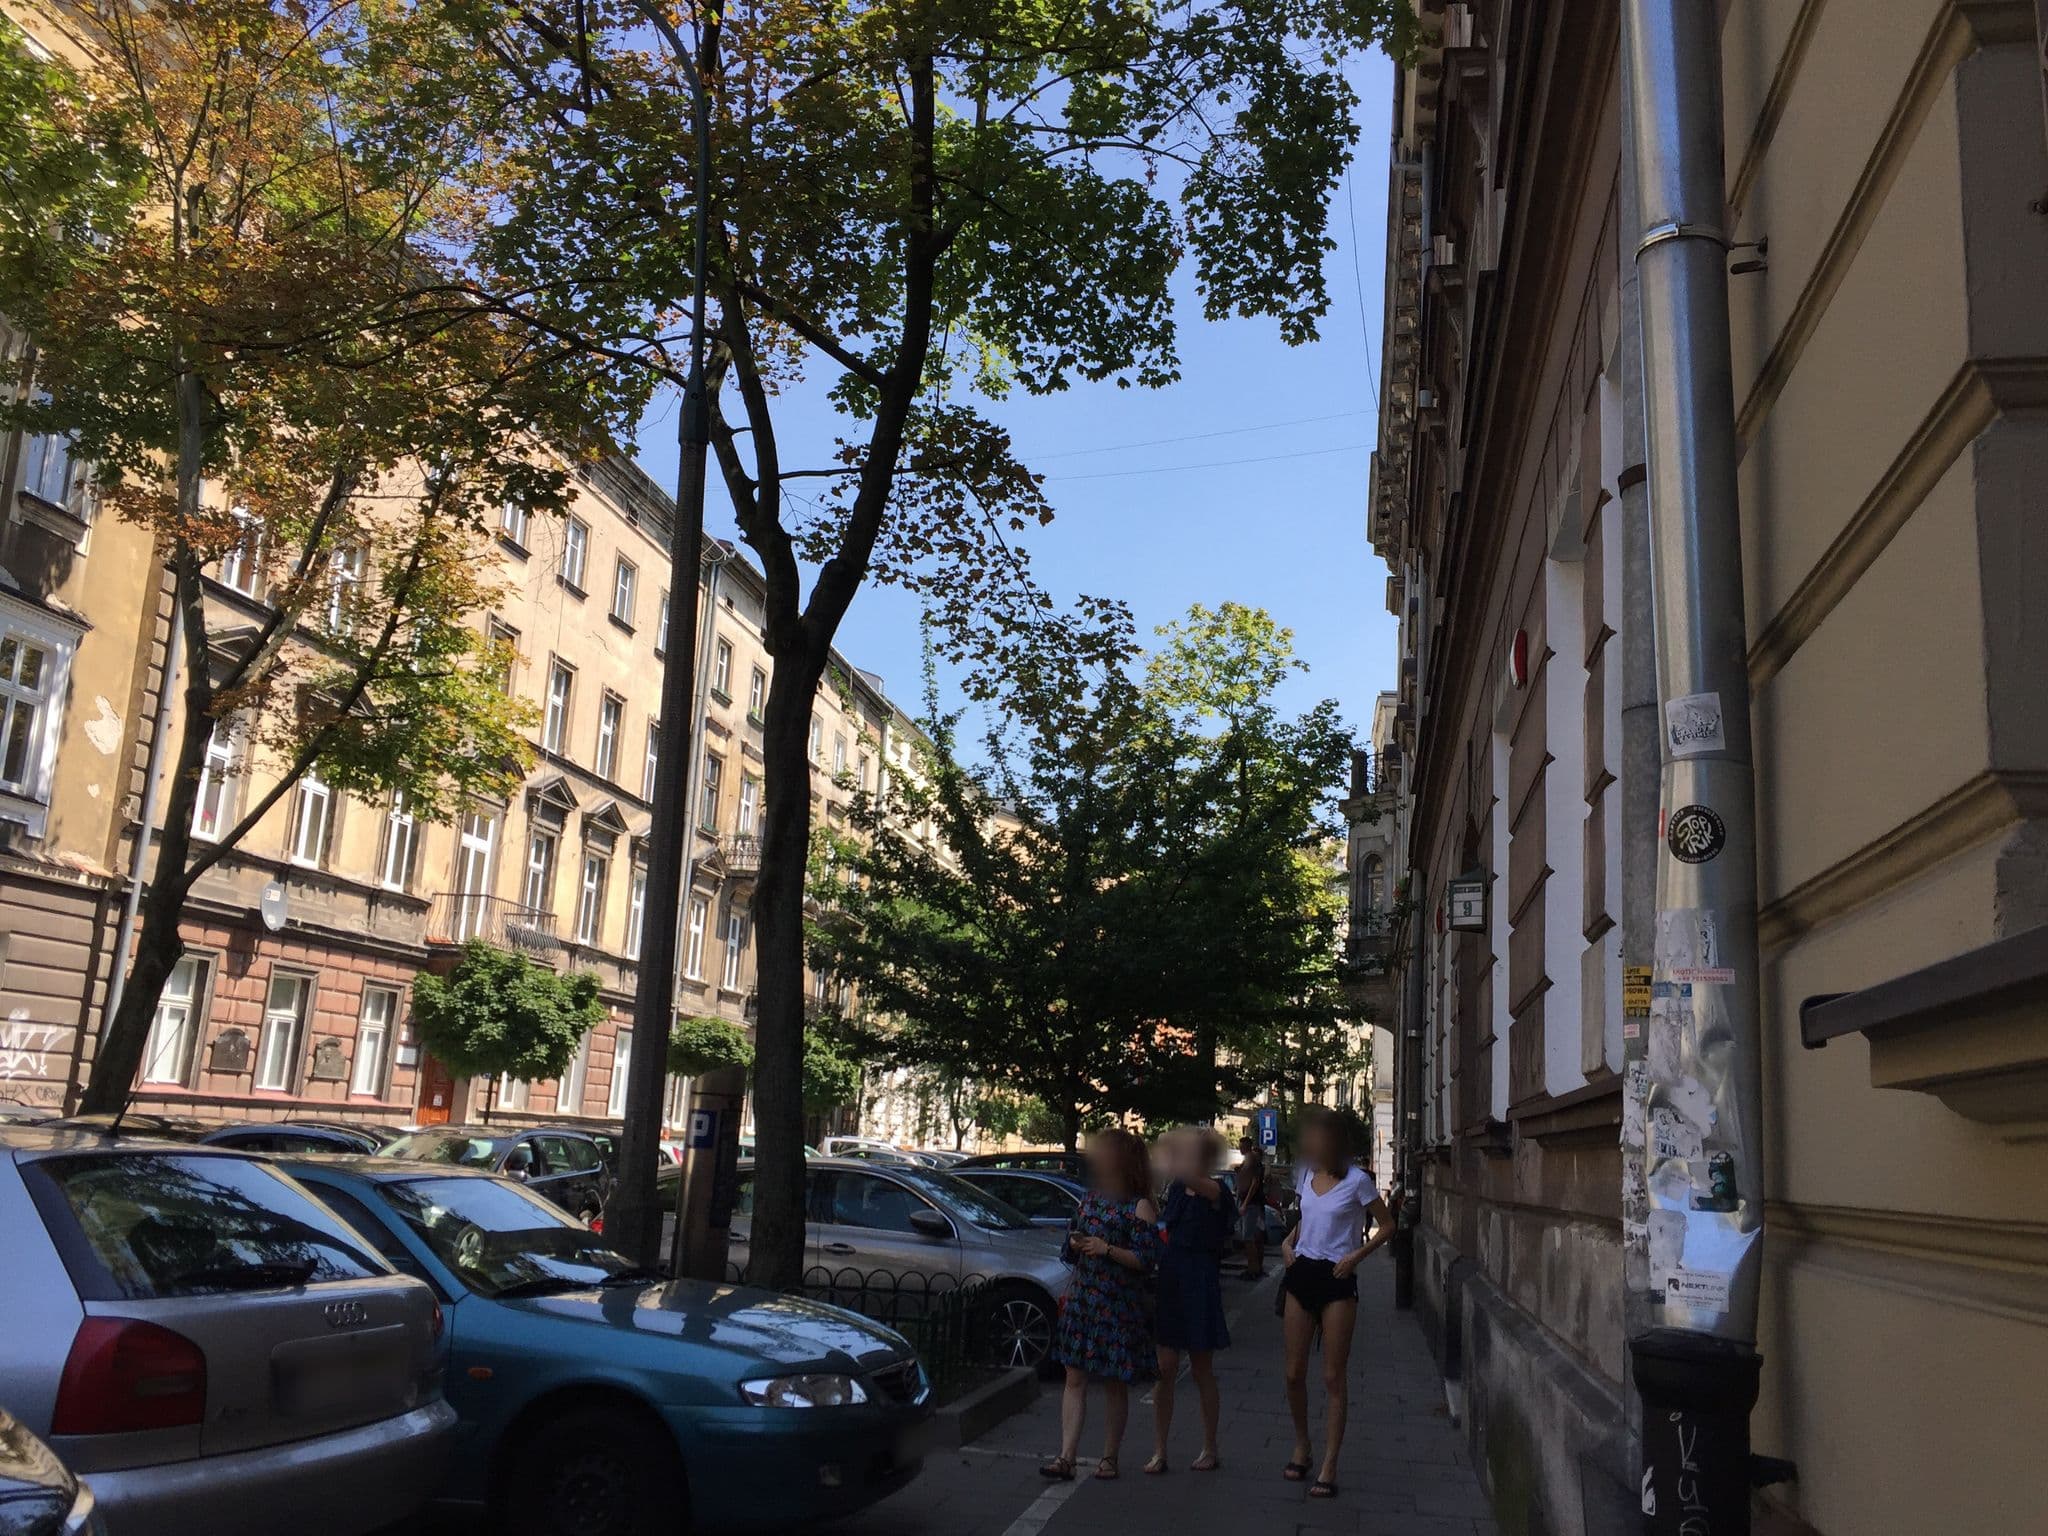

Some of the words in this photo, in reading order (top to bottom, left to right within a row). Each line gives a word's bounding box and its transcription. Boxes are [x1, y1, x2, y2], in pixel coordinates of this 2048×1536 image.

[1463, 901, 1473, 917] 9
[688, 1113, 711, 1147] P
[1263, 1129, 1273, 1144] P
